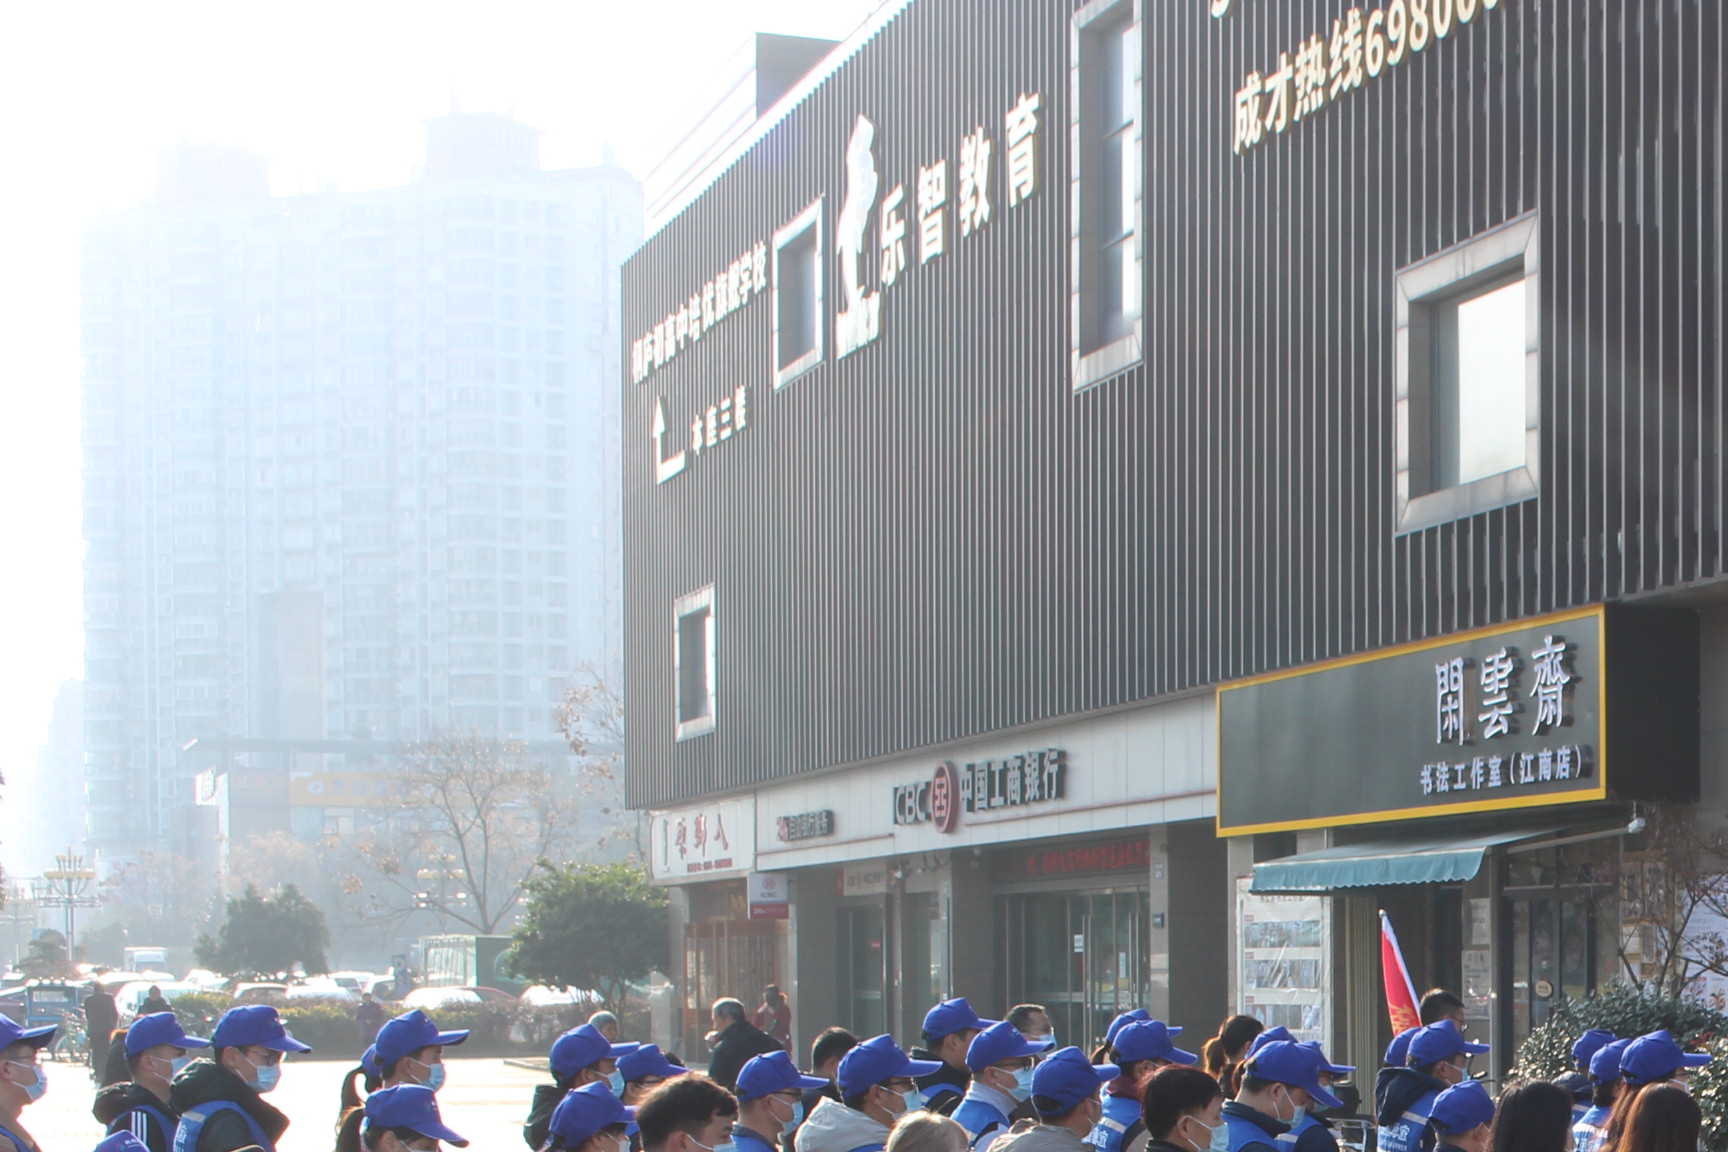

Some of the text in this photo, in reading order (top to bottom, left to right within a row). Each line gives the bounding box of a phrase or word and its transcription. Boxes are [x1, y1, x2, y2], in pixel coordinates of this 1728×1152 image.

[881, 92, 1040, 286] 乐智教育
[961, 748, 1066, 812] 中国工商银行
